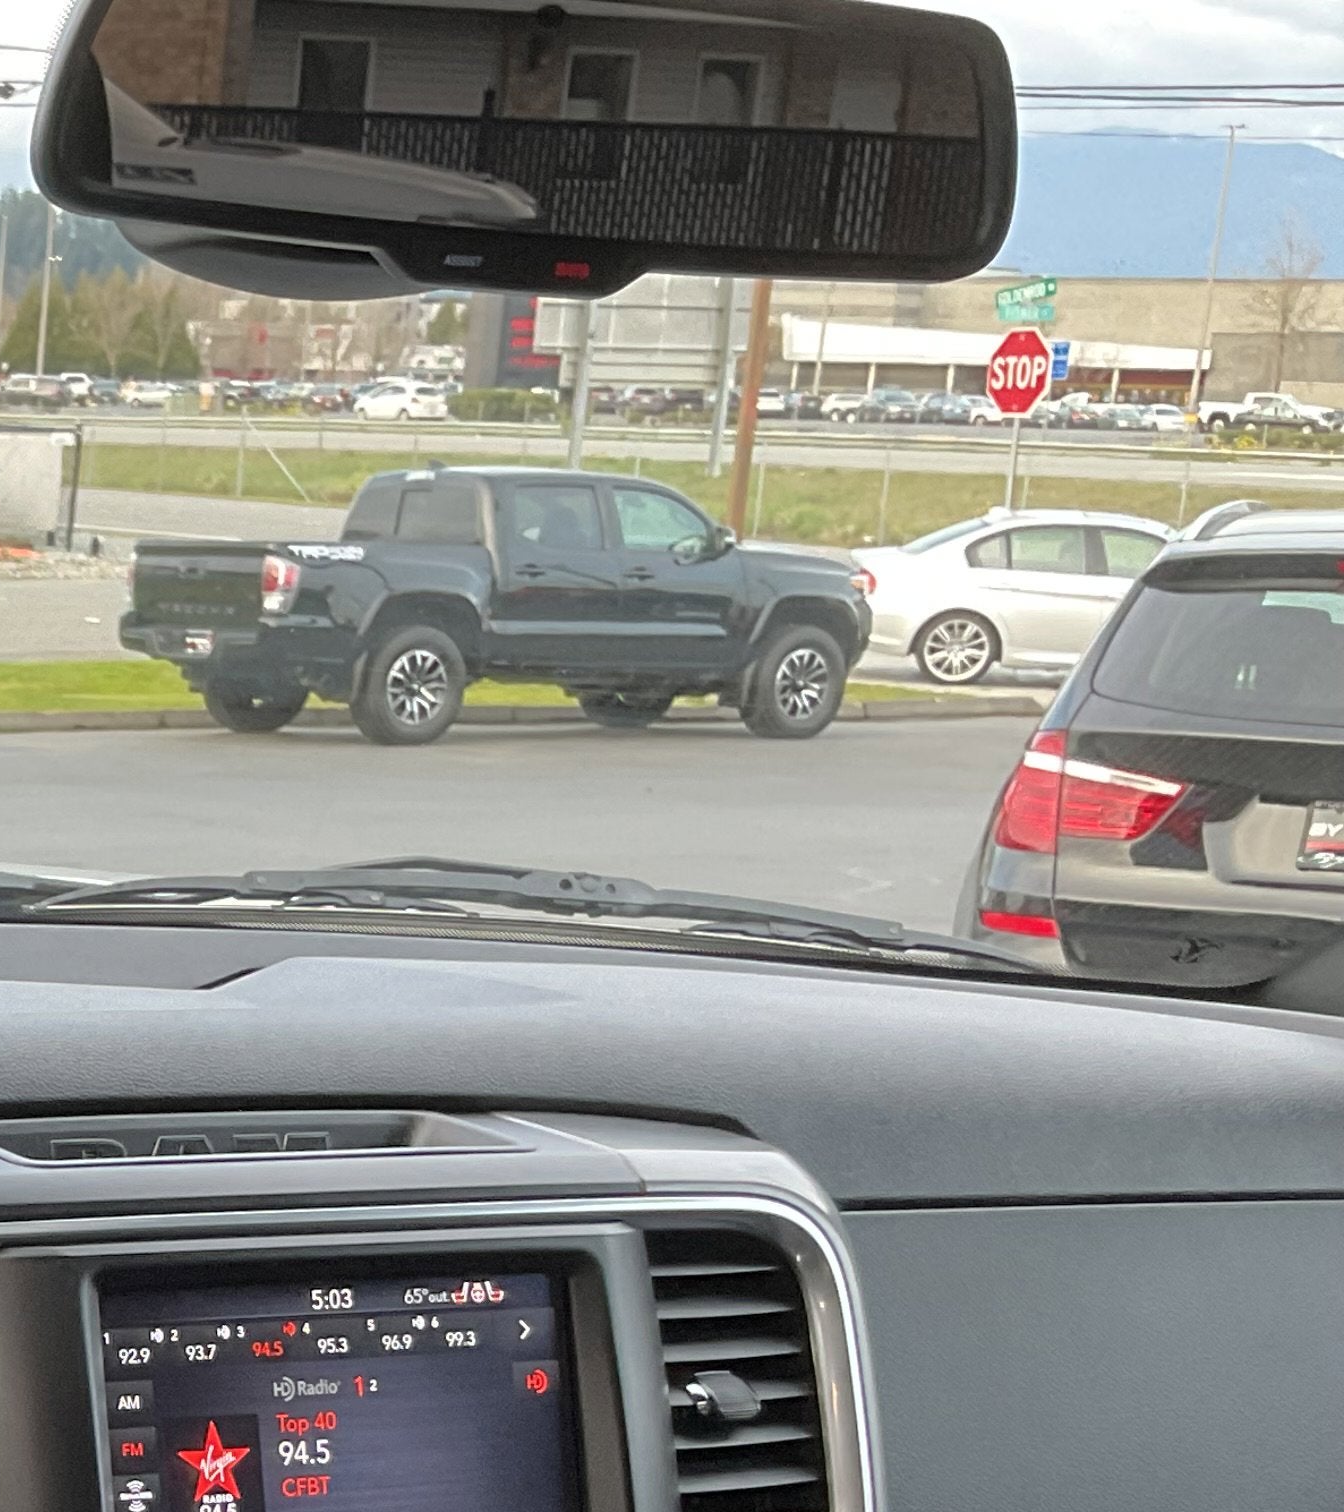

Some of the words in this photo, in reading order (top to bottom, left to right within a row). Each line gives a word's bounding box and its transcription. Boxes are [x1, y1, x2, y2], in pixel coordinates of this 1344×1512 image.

[991, 355, 1047, 390] STOP
[311, 1288, 353, 1310] 5:03
[317, 1337, 348, 1353] 95.3
[381, 1334, 412, 1350] 96.9
[445, 1331, 476, 1347] 99.3
[118, 1348, 150, 1364] 92.9
[185, 1344, 216, 1360] 93.7
[252, 1341, 284, 1357] 94.5
[297, 1380, 337, 1397] Radio
[117, 1395, 140, 1410] AM
[276, 1414, 309, 1436] Top
[314, 1412, 337, 1430] 40
[121, 1443, 143, 1456] FM
[278, 1440, 331, 1466] 94.5
[282, 1476, 331, 1497] CFBT
